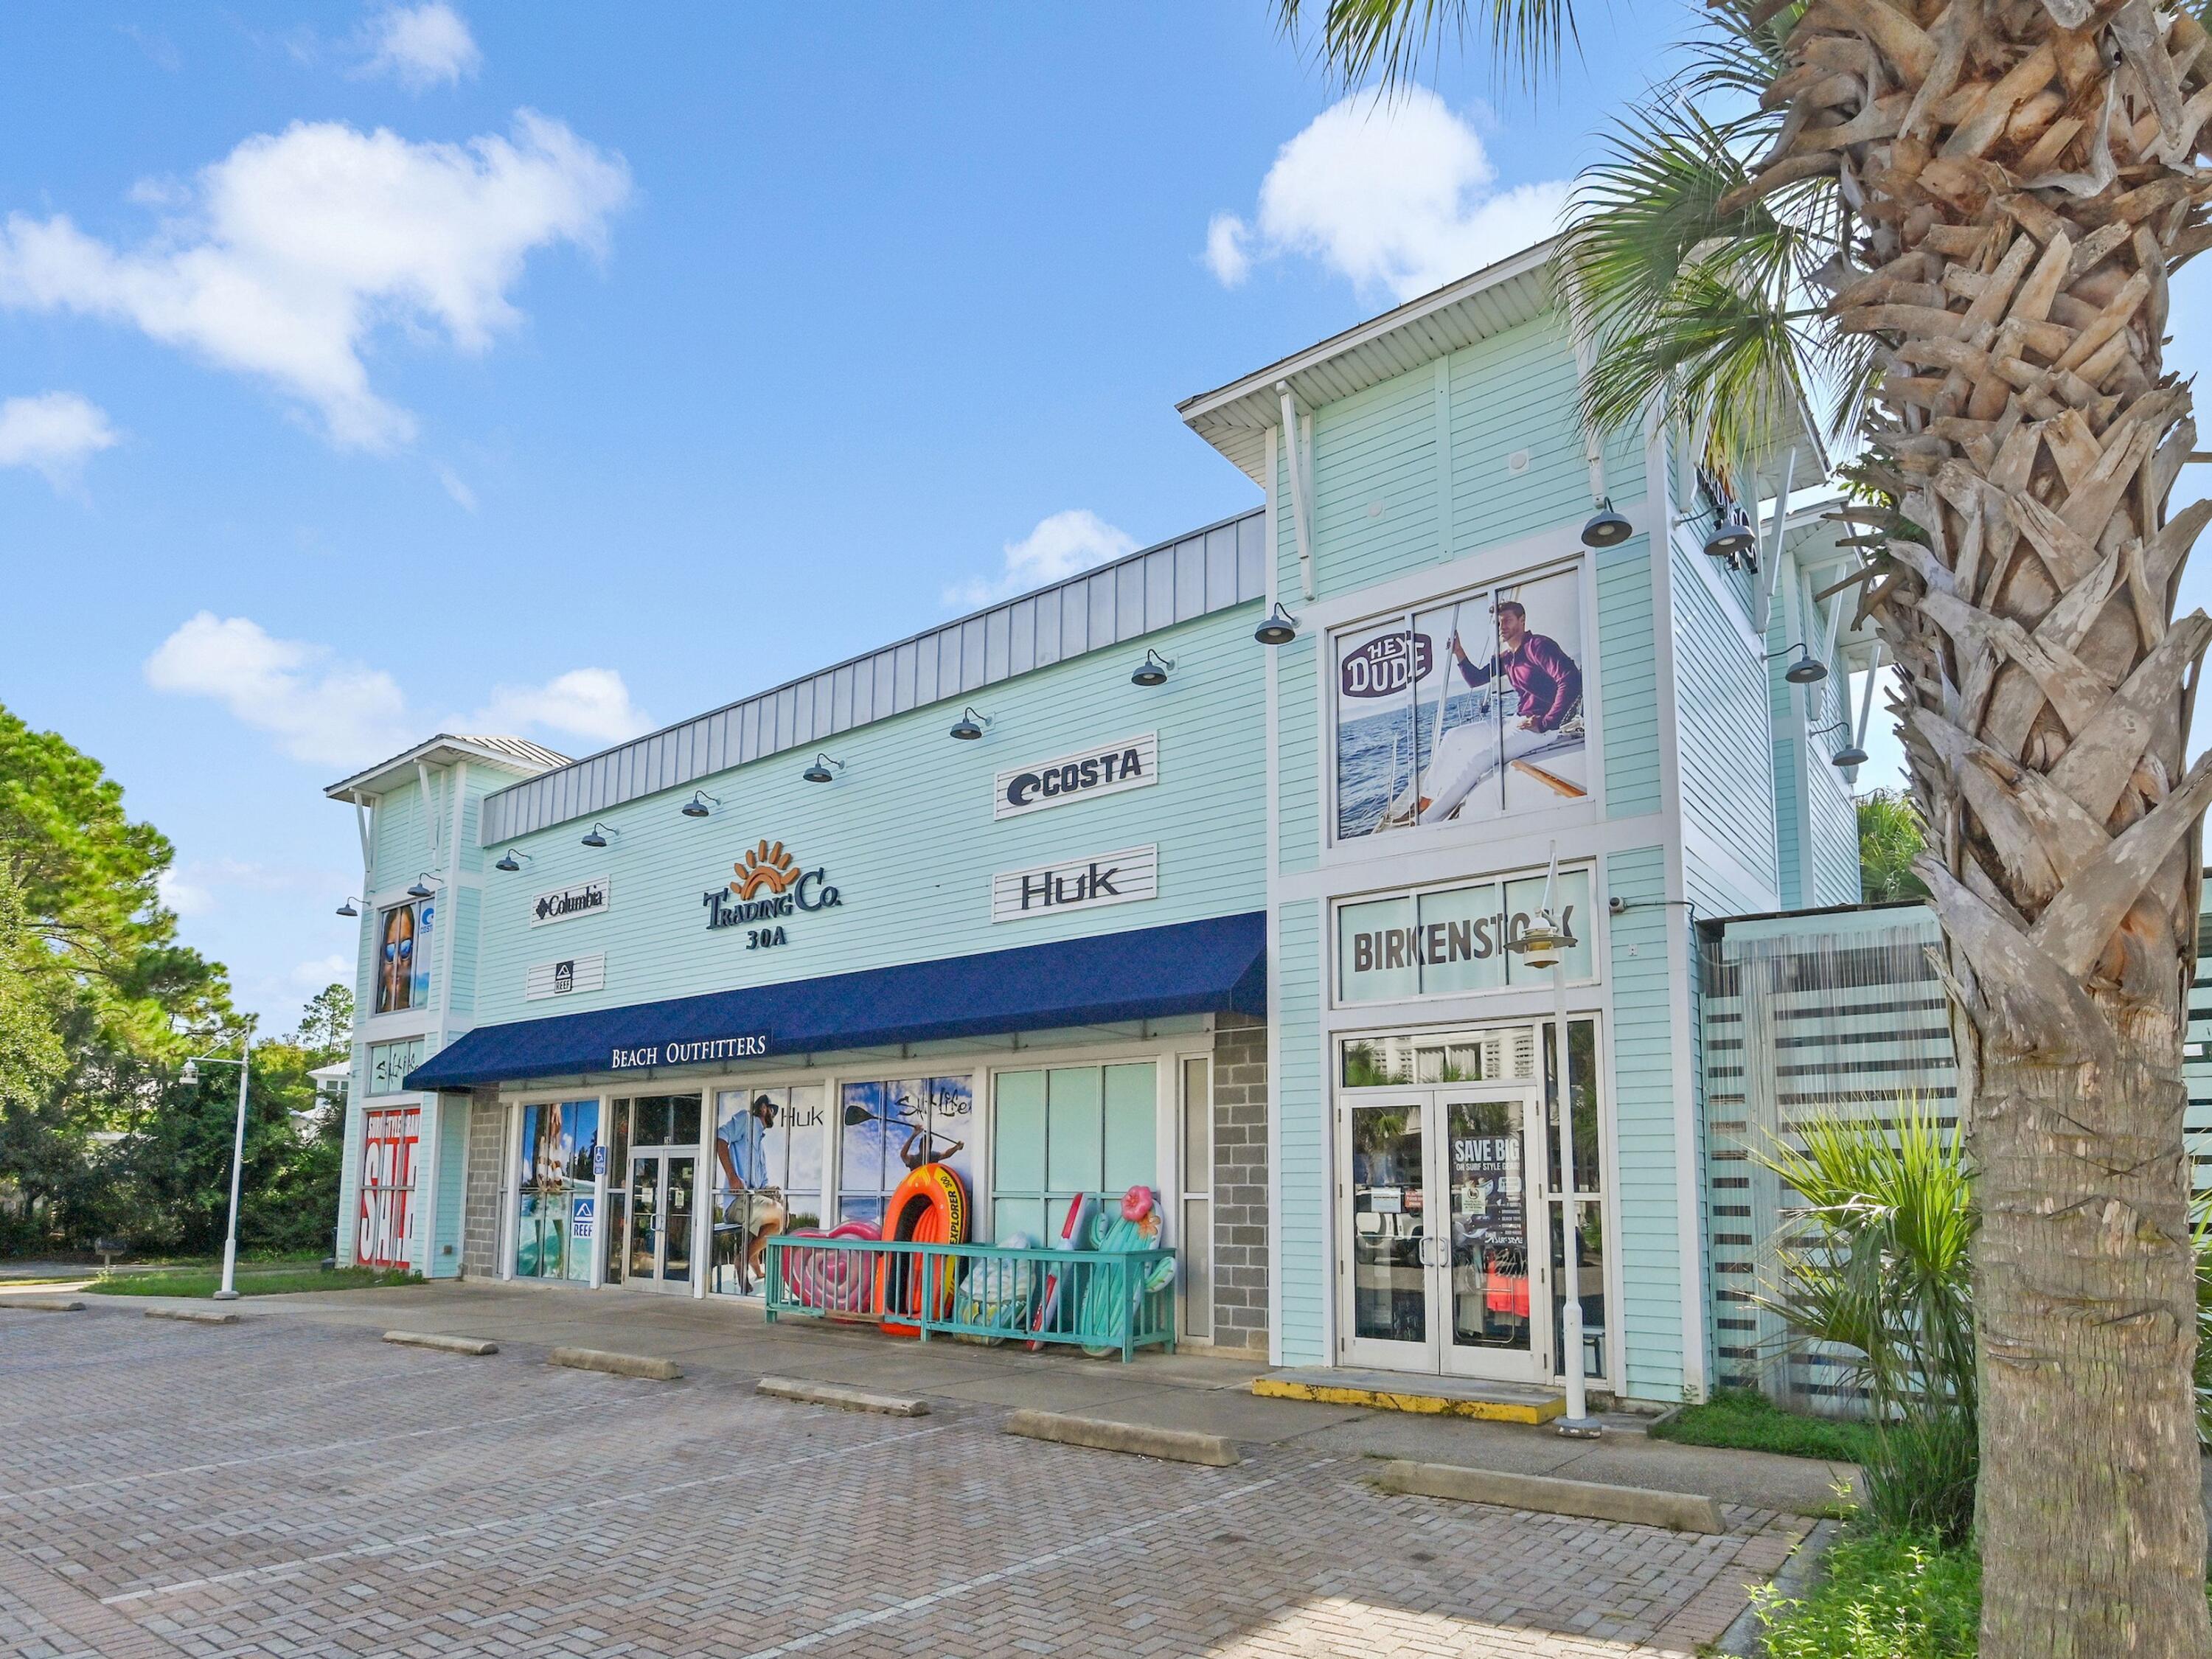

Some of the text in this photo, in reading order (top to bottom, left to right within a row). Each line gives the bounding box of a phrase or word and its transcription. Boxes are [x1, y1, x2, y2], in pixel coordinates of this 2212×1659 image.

[1367, 636, 1408, 660] HEY
[1347, 639, 1426, 692] DUDE
[1042, 748, 1142, 798] COSTA
[549, 885, 602, 917] Columbia
[420, 924, 434, 934] COST
[745, 926, 787, 950] 30A
[1354, 905, 1576, 973] BIRKENSTOK
[555, 979, 571, 992] REEF
[1455, 1138, 1520, 1162] SAVE BIG
[1483, 1163, 1501, 1171] STYLE
[940, 1176, 960, 1245] EXPLORER 300
[573, 1224, 593, 1237] REEF
